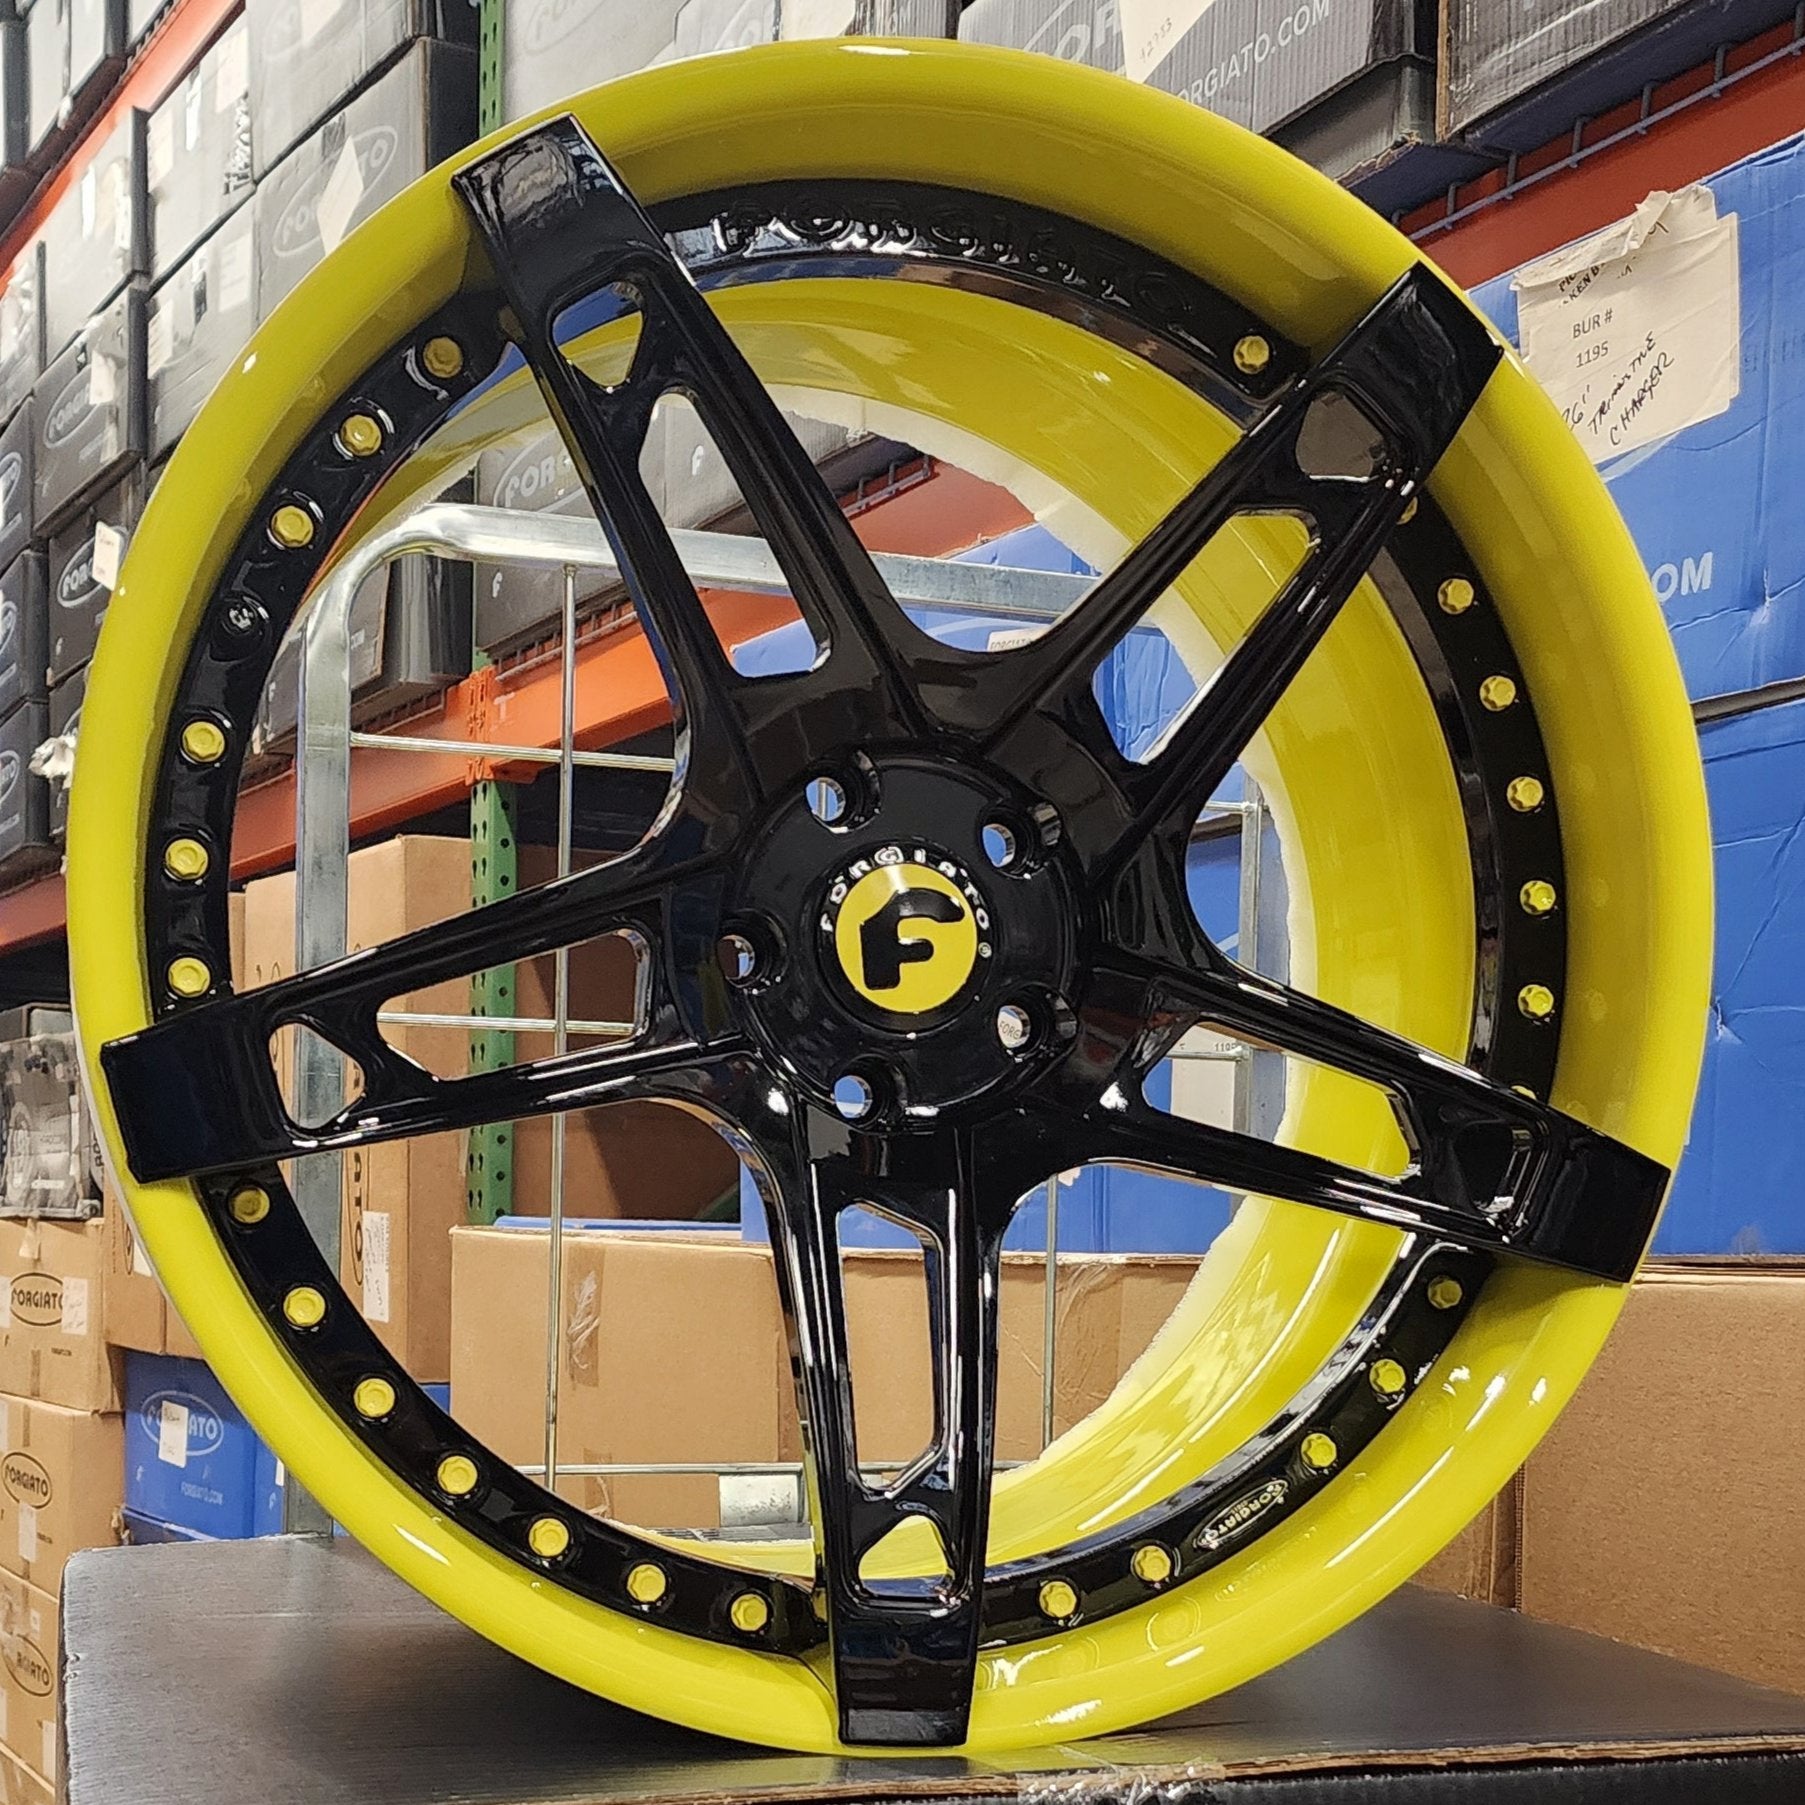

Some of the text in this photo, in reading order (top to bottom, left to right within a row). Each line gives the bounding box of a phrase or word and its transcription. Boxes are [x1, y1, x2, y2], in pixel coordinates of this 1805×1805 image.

[1175, 0, 1330, 106] ORGIATO.COM
[1572, 307, 1614, 339] BUR #
[1575, 341, 1609, 368] 1195
[1651, 552, 1713, 603] OM
[820, 845, 990, 933] FORGIATO
[859, 886, 965, 990] F
